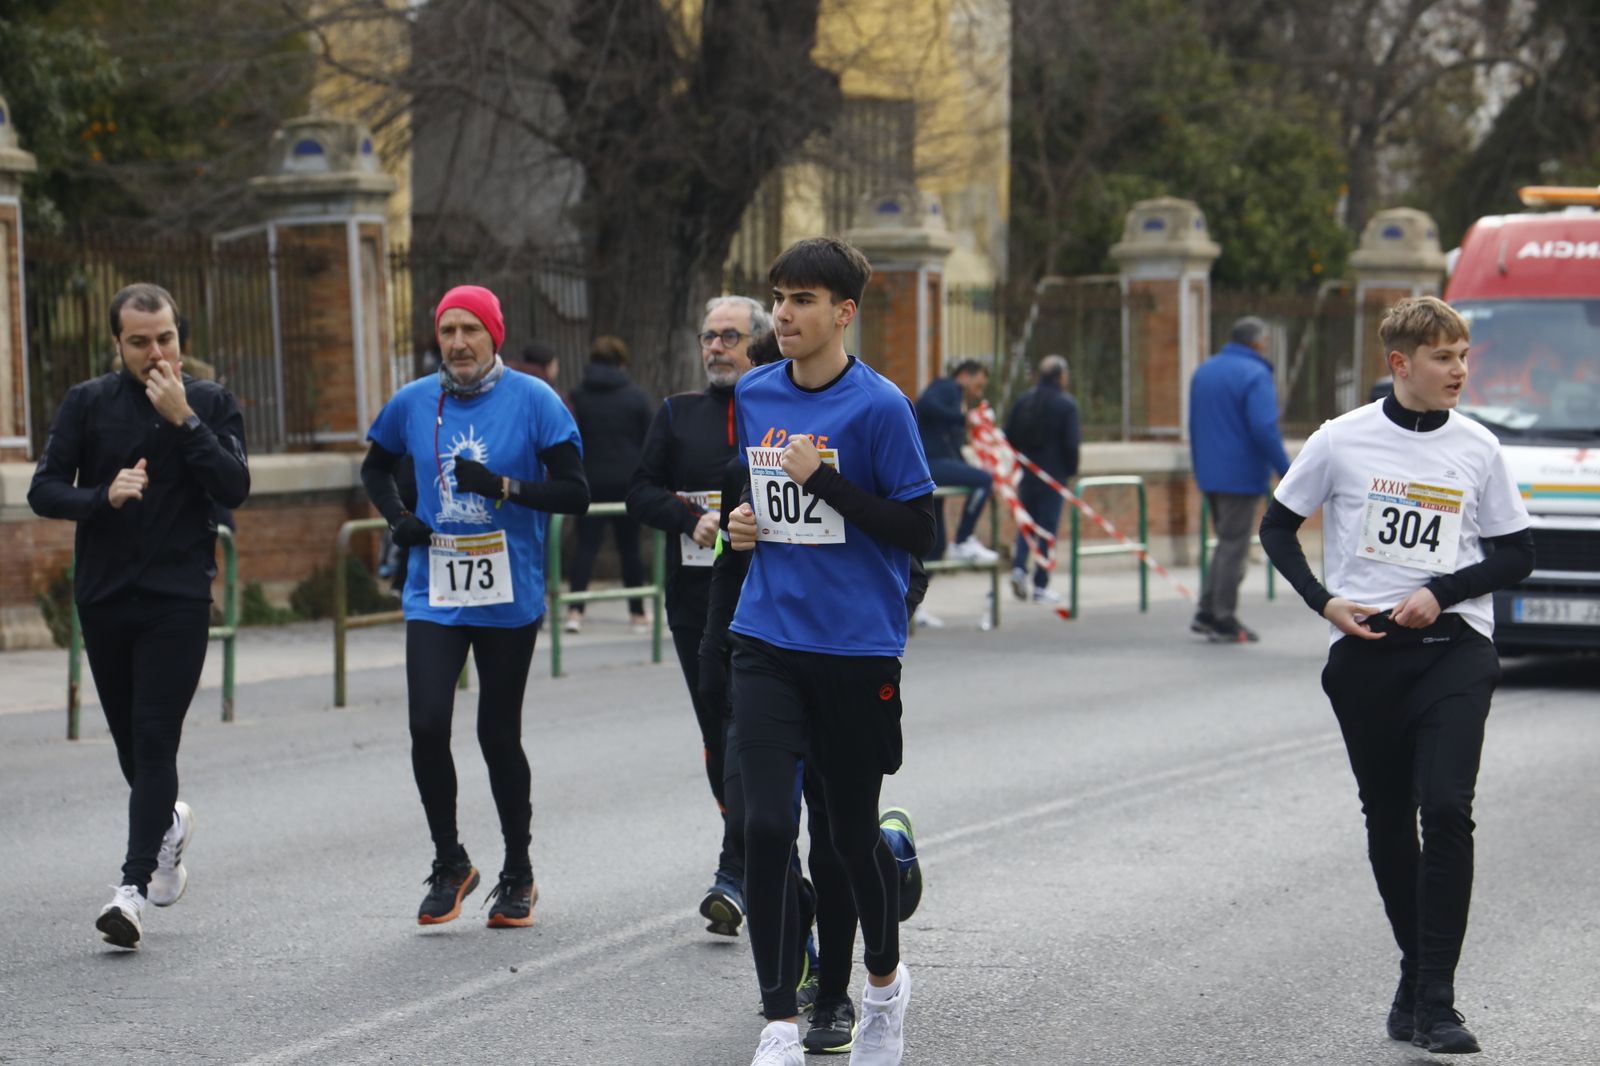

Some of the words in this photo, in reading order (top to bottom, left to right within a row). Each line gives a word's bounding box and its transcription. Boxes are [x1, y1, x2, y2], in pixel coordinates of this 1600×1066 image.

[752, 451, 782, 467] XXXIX
[766, 480, 822, 524] 602
[1371, 478, 1407, 497] XXXIX
[1378, 507, 1442, 552] 304
[446, 558, 494, 592] 173
